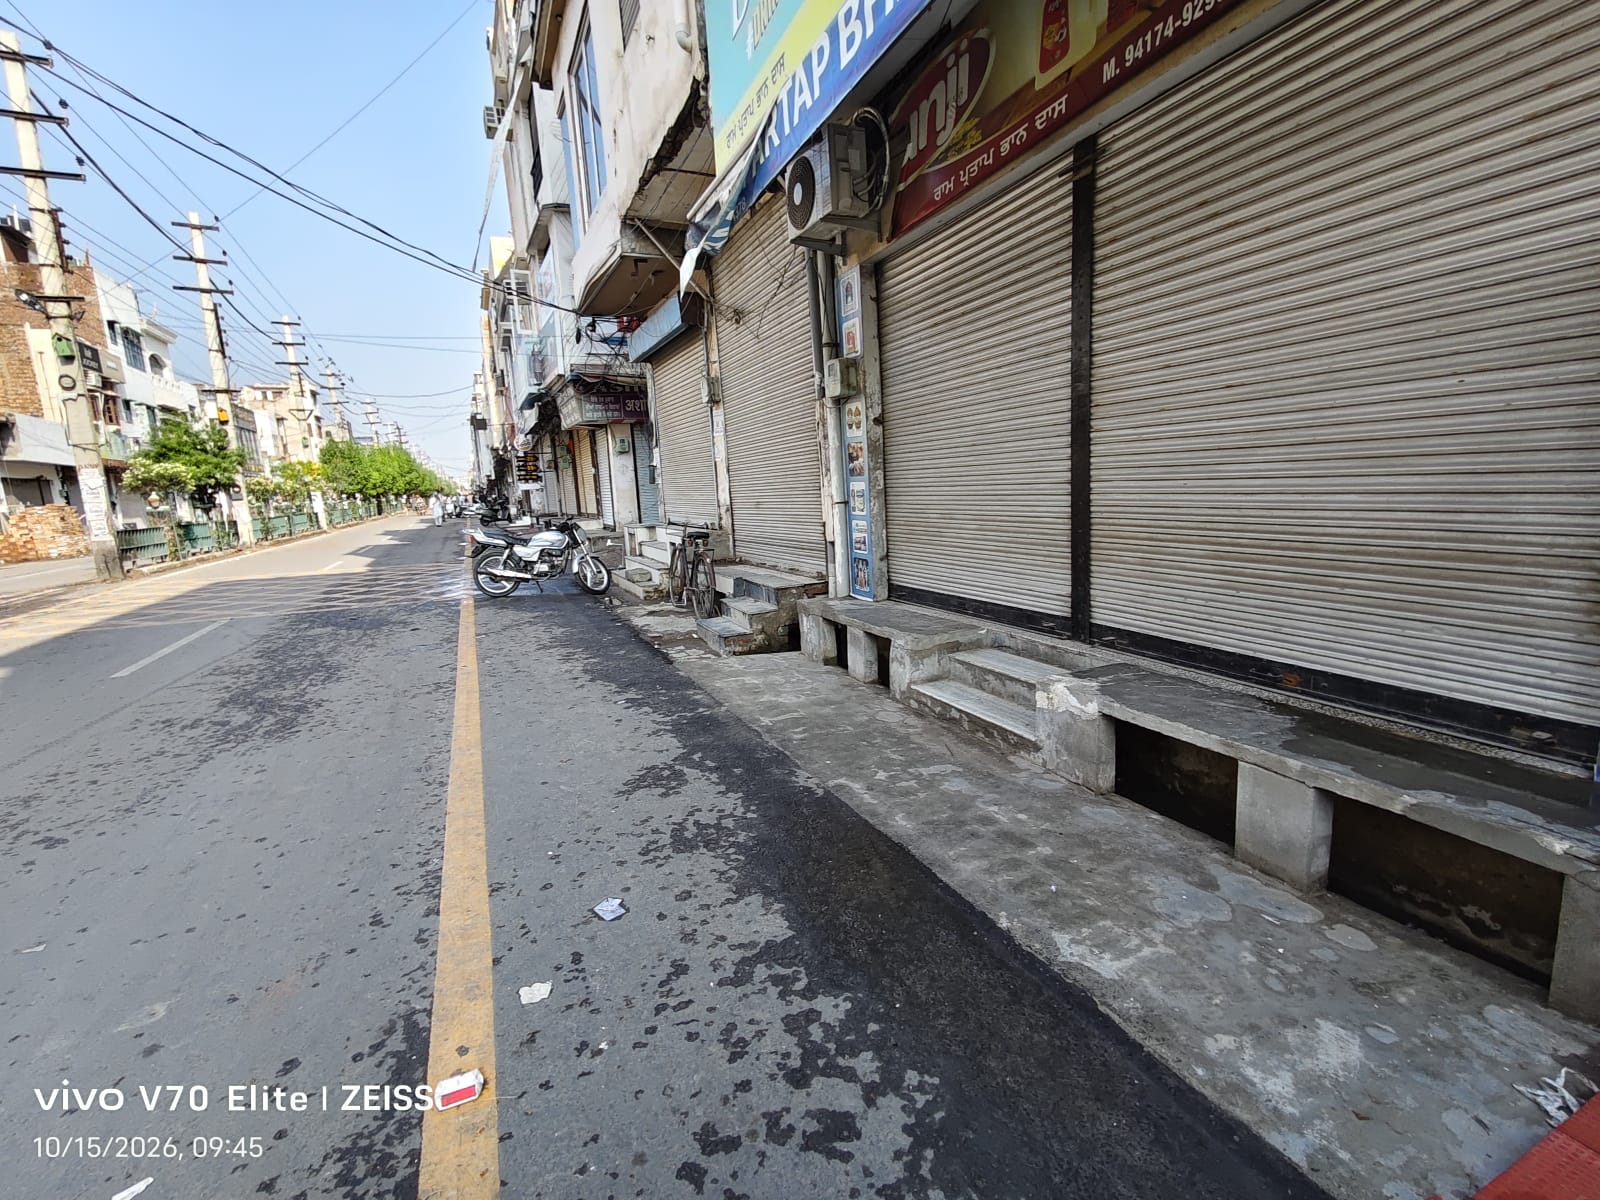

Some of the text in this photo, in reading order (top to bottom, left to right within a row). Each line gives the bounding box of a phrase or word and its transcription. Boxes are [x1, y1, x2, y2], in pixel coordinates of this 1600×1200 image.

[1102, 0, 1224, 84] M. 94174-92
[933, 94, 1068, 200] ਰਾਮ ਪ੍ਰਤਾਪ ਭਾਨ ਦਾਸ
